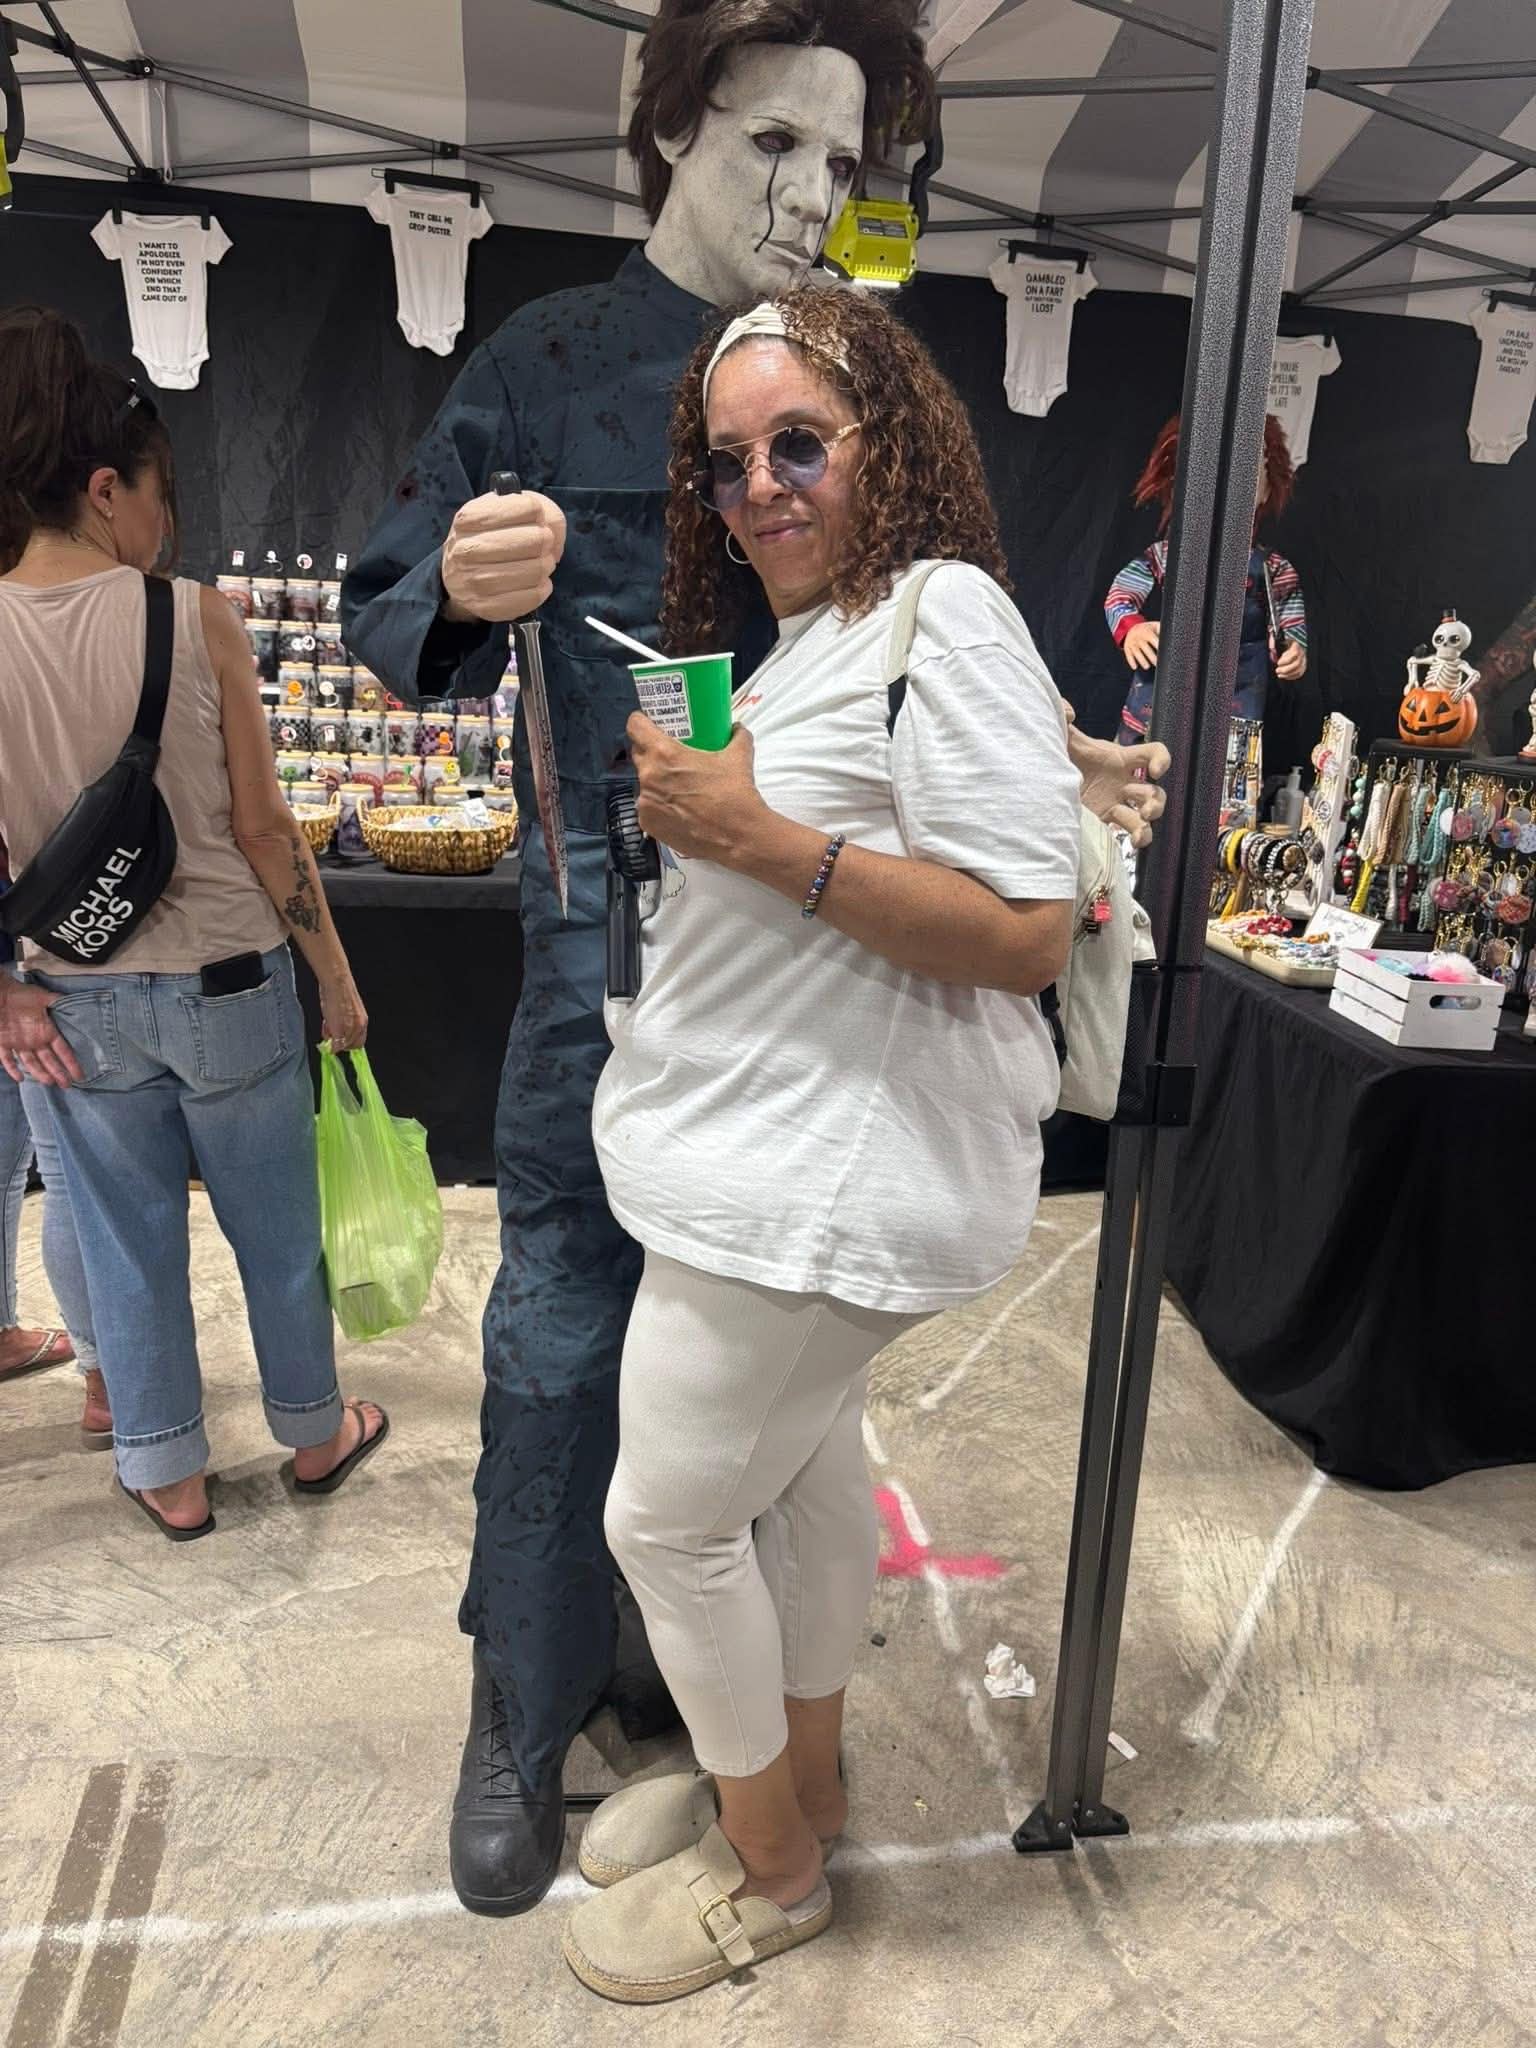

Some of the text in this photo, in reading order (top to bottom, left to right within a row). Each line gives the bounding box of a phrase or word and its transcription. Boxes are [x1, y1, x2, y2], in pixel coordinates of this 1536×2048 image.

[409, 210, 452, 224] THEY CALL ME
[409, 222, 426, 231] CROP
[139, 250, 181, 258] APOLOGIZE
[144, 276, 156, 284] ON
[1025, 285, 1038, 296] ON
[1046, 287, 1064, 297] FART
[162, 294, 176, 302] OUT
[1036, 304, 1054, 313] LOST
[51, 847, 142, 944] MICHAEL
[72, 896, 134, 958] KORS
